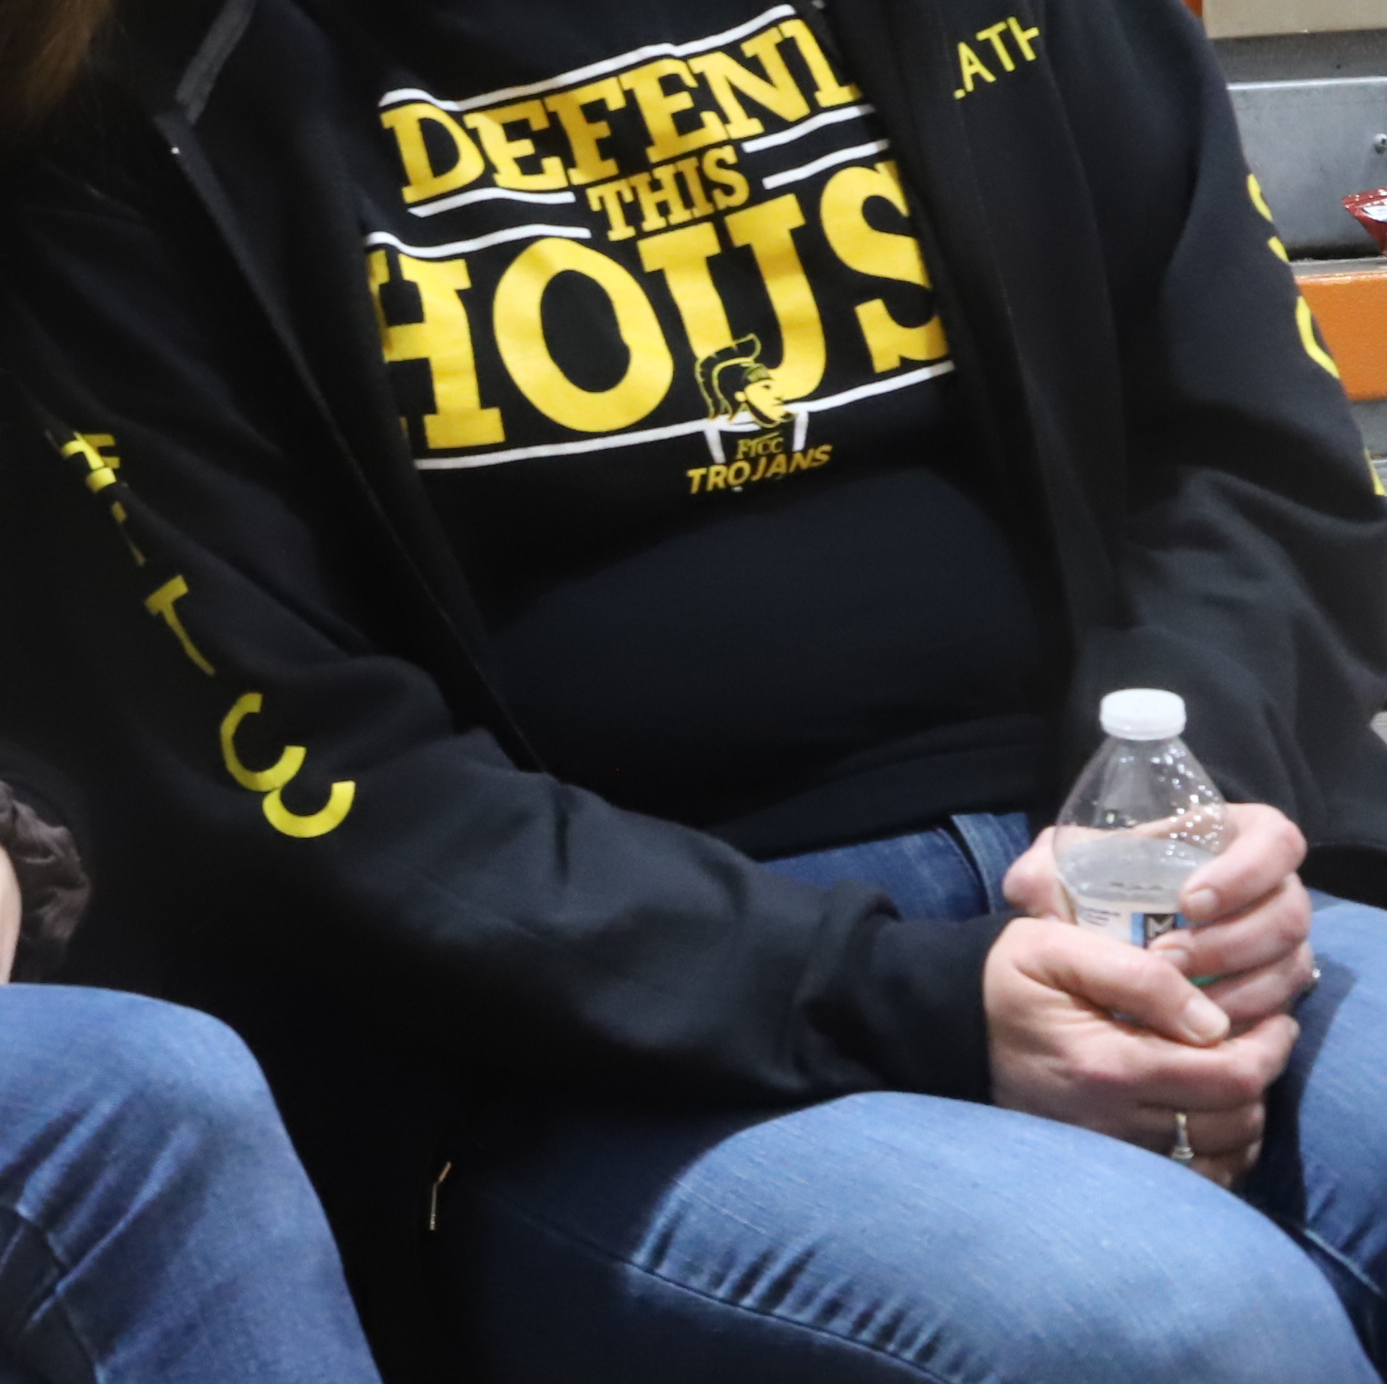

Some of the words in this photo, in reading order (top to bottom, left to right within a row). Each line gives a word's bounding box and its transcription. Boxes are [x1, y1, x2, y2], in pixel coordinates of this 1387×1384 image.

[586, 144, 751, 242] THIS
[367, 160, 949, 450] HOUS
[686, 443, 834, 495] TROJANS
